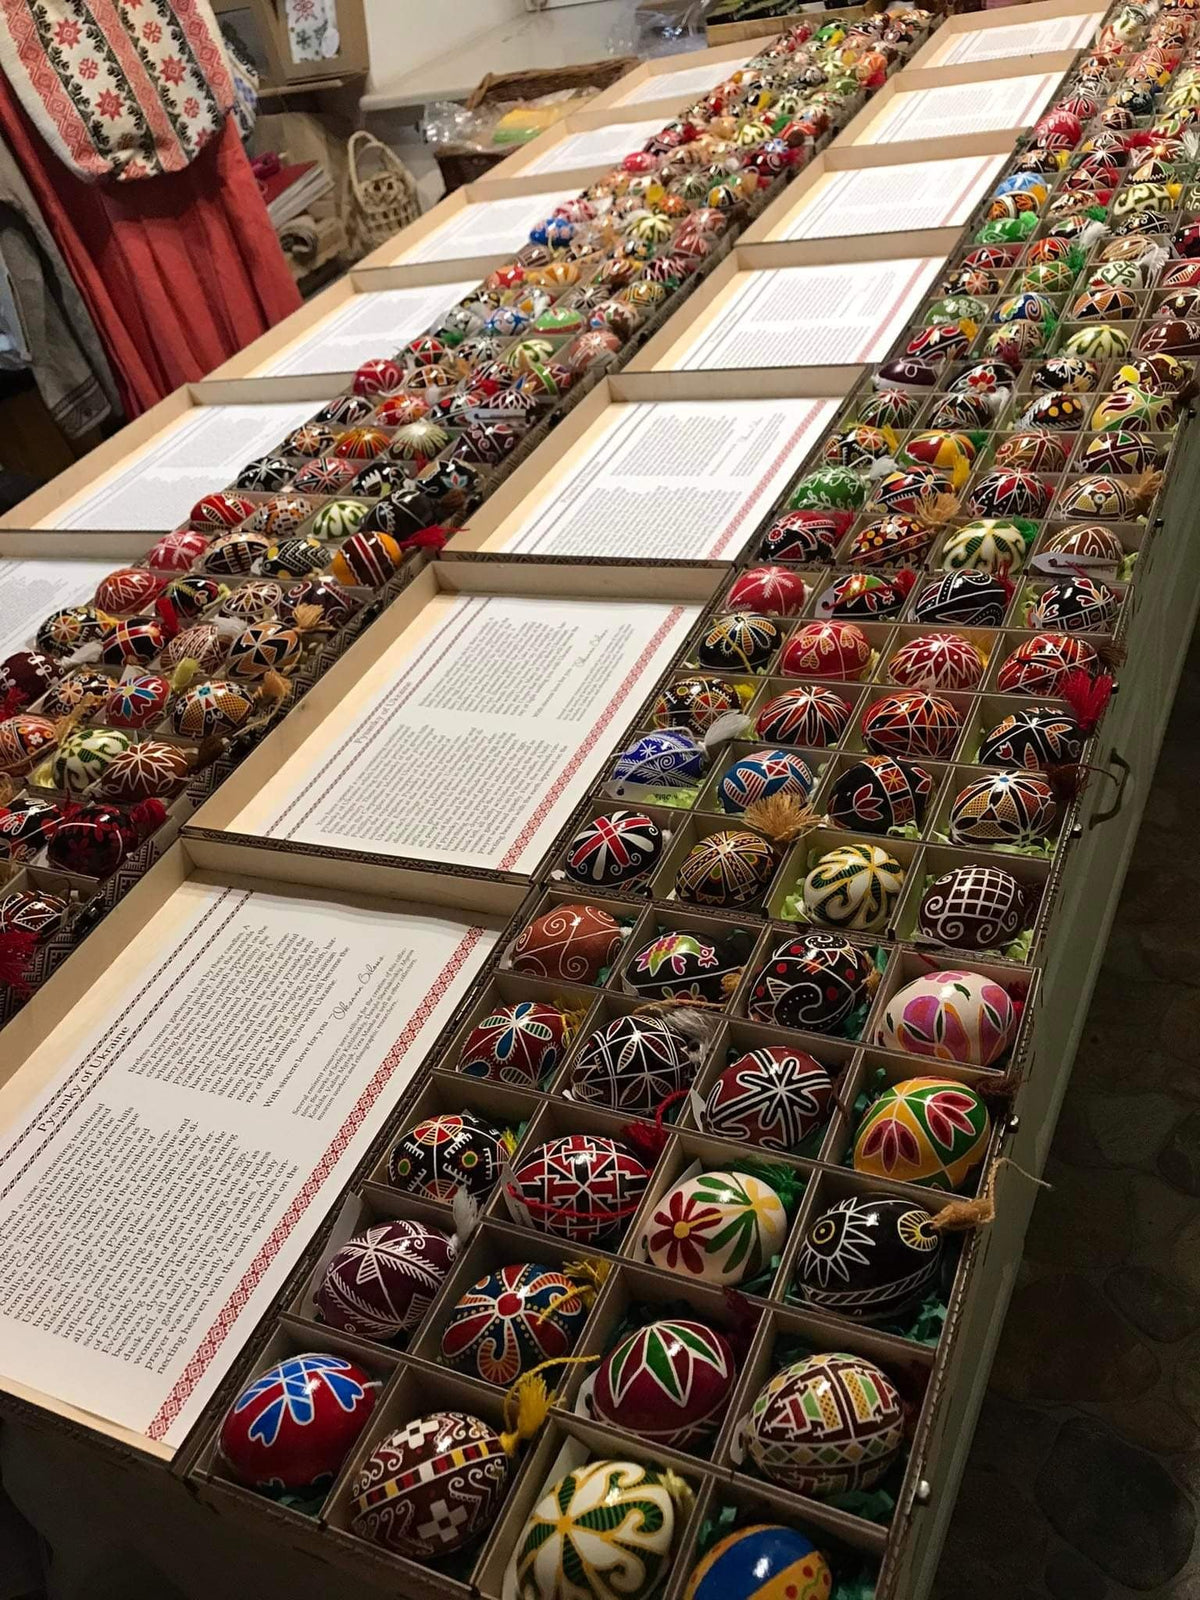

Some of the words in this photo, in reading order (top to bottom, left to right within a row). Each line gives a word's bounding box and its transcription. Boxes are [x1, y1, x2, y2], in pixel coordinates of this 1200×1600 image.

[252, 1056, 271, 1075] hope
[265, 1041, 282, 1056] that
[278, 1028, 292, 1041] this
[289, 996, 315, 1027] collection
[311, 981, 325, 995] will
[319, 957, 342, 982] become
[339, 947, 350, 957] the
[302, 1006, 317, 1022] with
[227, 1077, 246, 1098] mony
[243, 1062, 256, 1077] and
[264, 1023, 285, 1044] Many
[281, 1015, 290, 1023] of
[287, 1001, 300, 1016] you
[297, 983, 314, 1001] share
[309, 951, 337, 982] Ukrainian
[292, 1023, 305, 1038] you
[274, 1037, 297, 1063] uniting
[259, 1063, 277, 1081] light
[262, 1089, 281, 1107] With
[278, 1062, 299, 1088] sincere
[294, 1046, 311, 1063] love
[306, 1035, 318, 1046] for
[315, 1021, 329, 1036] you
[36, 1084, 85, 1132] Pysanky
[79, 1069, 94, 1082] of
[89, 1026, 131, 1068] Ukraine
[255, 1080, 264, 1090] of
[245, 1090, 258, 1103] ray
[129, 1147, 158, 1183] previous
[247, 1151, 271, 1180] tireless
[283, 1165, 299, 1179] the
[27, 1241, 53, 1270] region
[50, 1229, 61, 1240] of
[59, 1200, 84, 1229] central
[109, 1154, 119, 1164] as
[116, 1136, 133, 1153] well
[131, 1126, 141, 1136] as
[115, 1182, 132, 1196] the
[154, 1181, 179, 1212] ancient
[234, 1180, 252, 1195] the
[278, 1180, 290, 1192] on
[51, 1280, 71, 1303] each
[68, 1248, 94, 1279] village
[91, 1229, 108, 1247] was
[105, 1197, 133, 1229] famous
[129, 1182, 144, 1197] for
[139, 1163, 158, 1182] their
[155, 1134, 179, 1162] unique
[176, 1118, 191, 1134] and
[111, 1196, 120, 1207] of
[229, 1196, 241, 1206] as
[250, 1193, 280, 1233] appeared
[85, 1292, 111, 1326] people
[107, 1268, 129, 1292] from
[124, 1246, 146, 1267] long
[143, 1229, 157, 1246] ago
[155, 1185, 188, 1227] venerated
[184, 1170, 198, 1185] the
[196, 1155, 211, 1170] egg
[207, 1144, 217, 1155] as
[213, 1130, 227, 1144] the
[93, 1208, 113, 1231] onset
[132, 1212, 156, 1235] these
[141, 1288, 164, 1311] dyes
[162, 1268, 178, 1287] and
[172, 1252, 189, 1267] the
[187, 1232, 204, 1251] wax
[201, 1199, 228, 1230] writing
[223, 1177, 241, 1198] tools
[239, 1159, 253, 1177] and
[250, 1150, 260, 1159] as
[211, 1205, 233, 1234] stilled
[78, 1232, 95, 1246] the
[83, 1314, 108, 1347] source
[106, 1300, 117, 1313] of
[112, 1285, 129, 1301] life
[127, 1265, 143, 1284] and
[140, 1249, 155, 1264] the
[151, 1214, 180, 1249] attitude
[174, 1178, 204, 1213] towards
[201, 1164, 215, 1178] the
[212, 1134, 238, 1163] writing
[126, 1235, 141, 1247] to
[234, 1234, 252, 1257] earth
[72, 1248, 83, 1258] at
[93, 1338, 103, 1350] of
[101, 1296, 133, 1339] pysanky
[131, 1276, 148, 1294] was
[145, 1256, 162, 1275] that
[160, 1244, 170, 1255] of
[168, 1221, 187, 1245] great
[181, 1194, 205, 1220] honor
[203, 1176, 218, 1194] and
[101, 1300, 146, 1353] Everything
[141, 1278, 158, 1297] was
[156, 1236, 188, 1278] prepared
[184, 1226, 196, 1236] in
[219, 1172, 234, 1186] the
[108, 1248, 132, 1272] harm
[133, 1327, 163, 1364] women
[161, 1282, 192, 1326] gathered
[189, 1271, 200, 1282] to
[198, 1259, 210, 1271] sit
[204, 1245, 219, 1258] by
[213, 1223, 233, 1244] their
[249, 1179, 265, 1188] A
[259, 1159, 278, 1178] holy
[184, 1235, 214, 1275] activities
[221, 1258, 236, 1273] the
[51, 1258, 75, 1281] Even
[144, 1334, 169, 1370] prayer
[167, 1313, 185, 1333] was
[182, 1289, 200, 1312] read
[237, 1214, 253, 1228] the
[250, 1178, 277, 1214] symbols
[93, 1273, 113, 1298] great
[165, 1275, 186, 1300] daily
[206, 1275, 225, 1296] with
[61, 1298, 94, 1338] inflicted
[155, 1301, 168, 1314] all
[180, 1299, 209, 1334] heaven
[123, 1336, 144, 1361] dusk
[157, 1335, 187, 1374] necting
